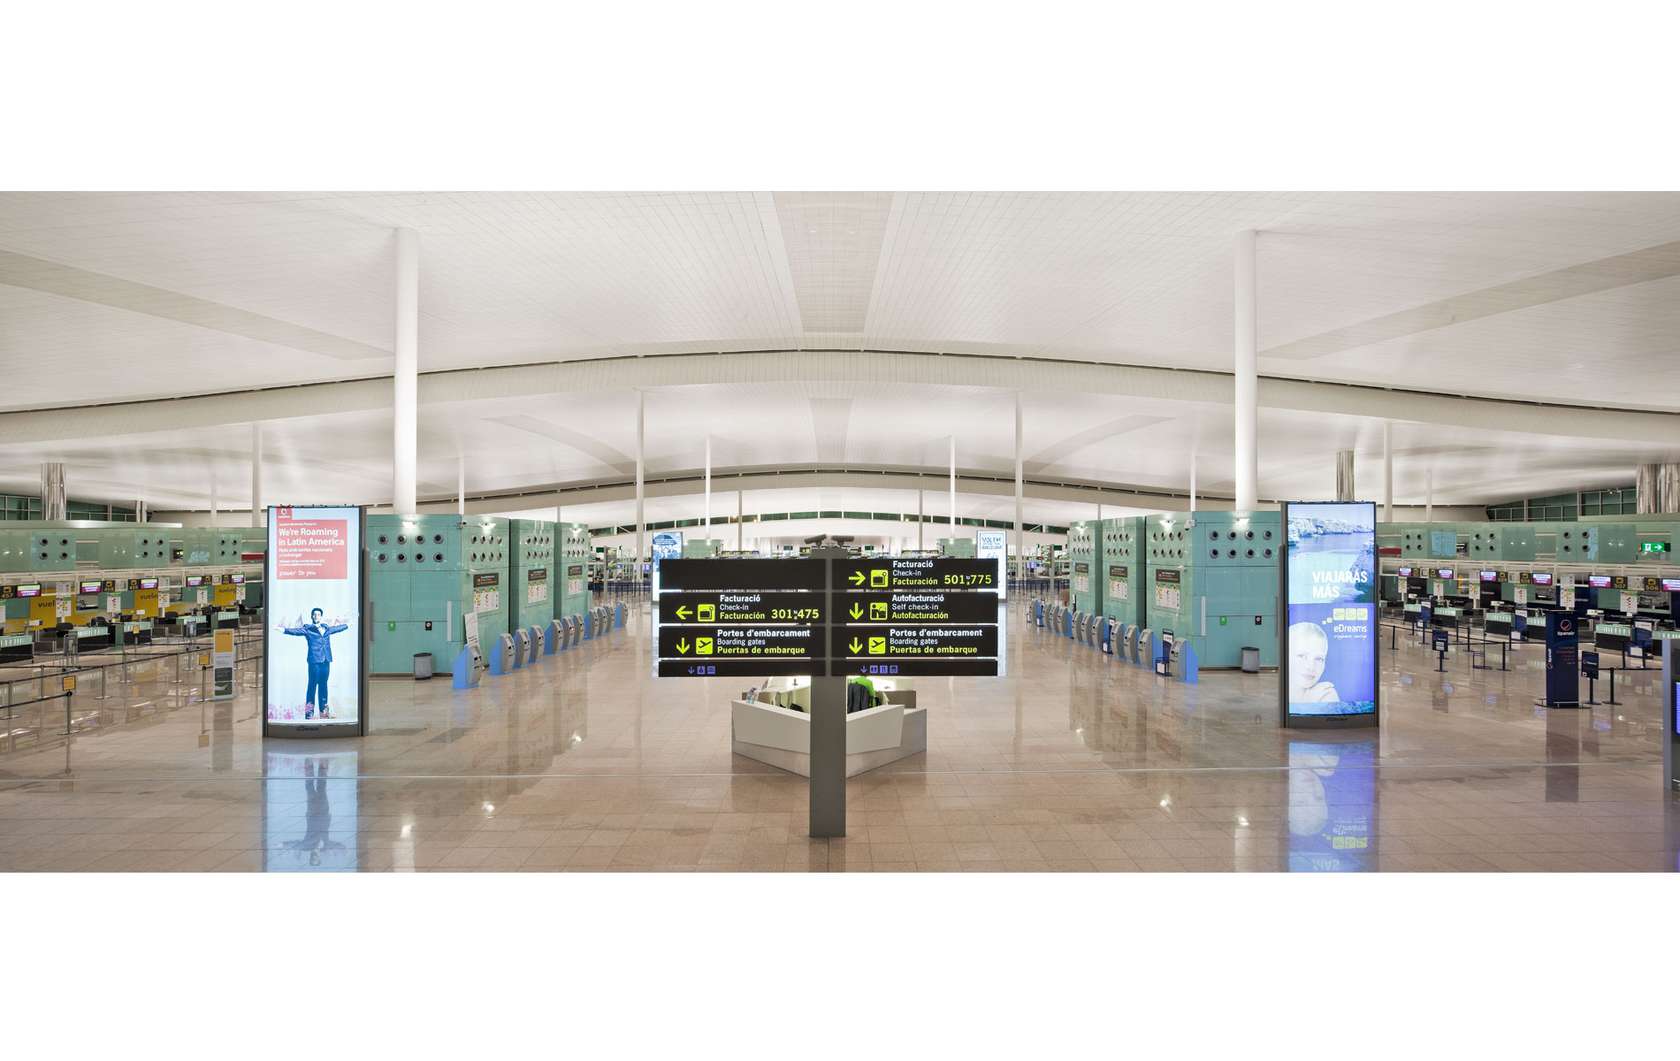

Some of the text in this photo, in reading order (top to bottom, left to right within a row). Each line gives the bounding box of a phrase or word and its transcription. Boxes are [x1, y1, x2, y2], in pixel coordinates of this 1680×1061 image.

[300, 528, 338, 537] Roaming
[287, 538, 307, 546] Latin
[308, 538, 345, 546] America
[892, 560, 934, 568] Facturació
[1312, 567, 1368, 583] VIAJARÁS
[892, 577, 938, 585] Facturación
[1312, 583, 1340, 599] MÁS
[719, 594, 761, 602] Facturació
[891, 594, 945, 602] Autofacturació
[719, 603, 749, 611] Check-in
[719, 611, 766, 619] Facturación
[891, 611, 949, 619] Autofacturación
[1333, 624, 1367, 633] eDreams
[717, 629, 811, 637] Portes d'embarcament
[889, 629, 983, 637] Portes d'embarcament
[717, 638, 746, 646] Boarding
[717, 646, 806, 655] Puertas de embarque
[889, 646, 978, 655] Puertas de embarque
